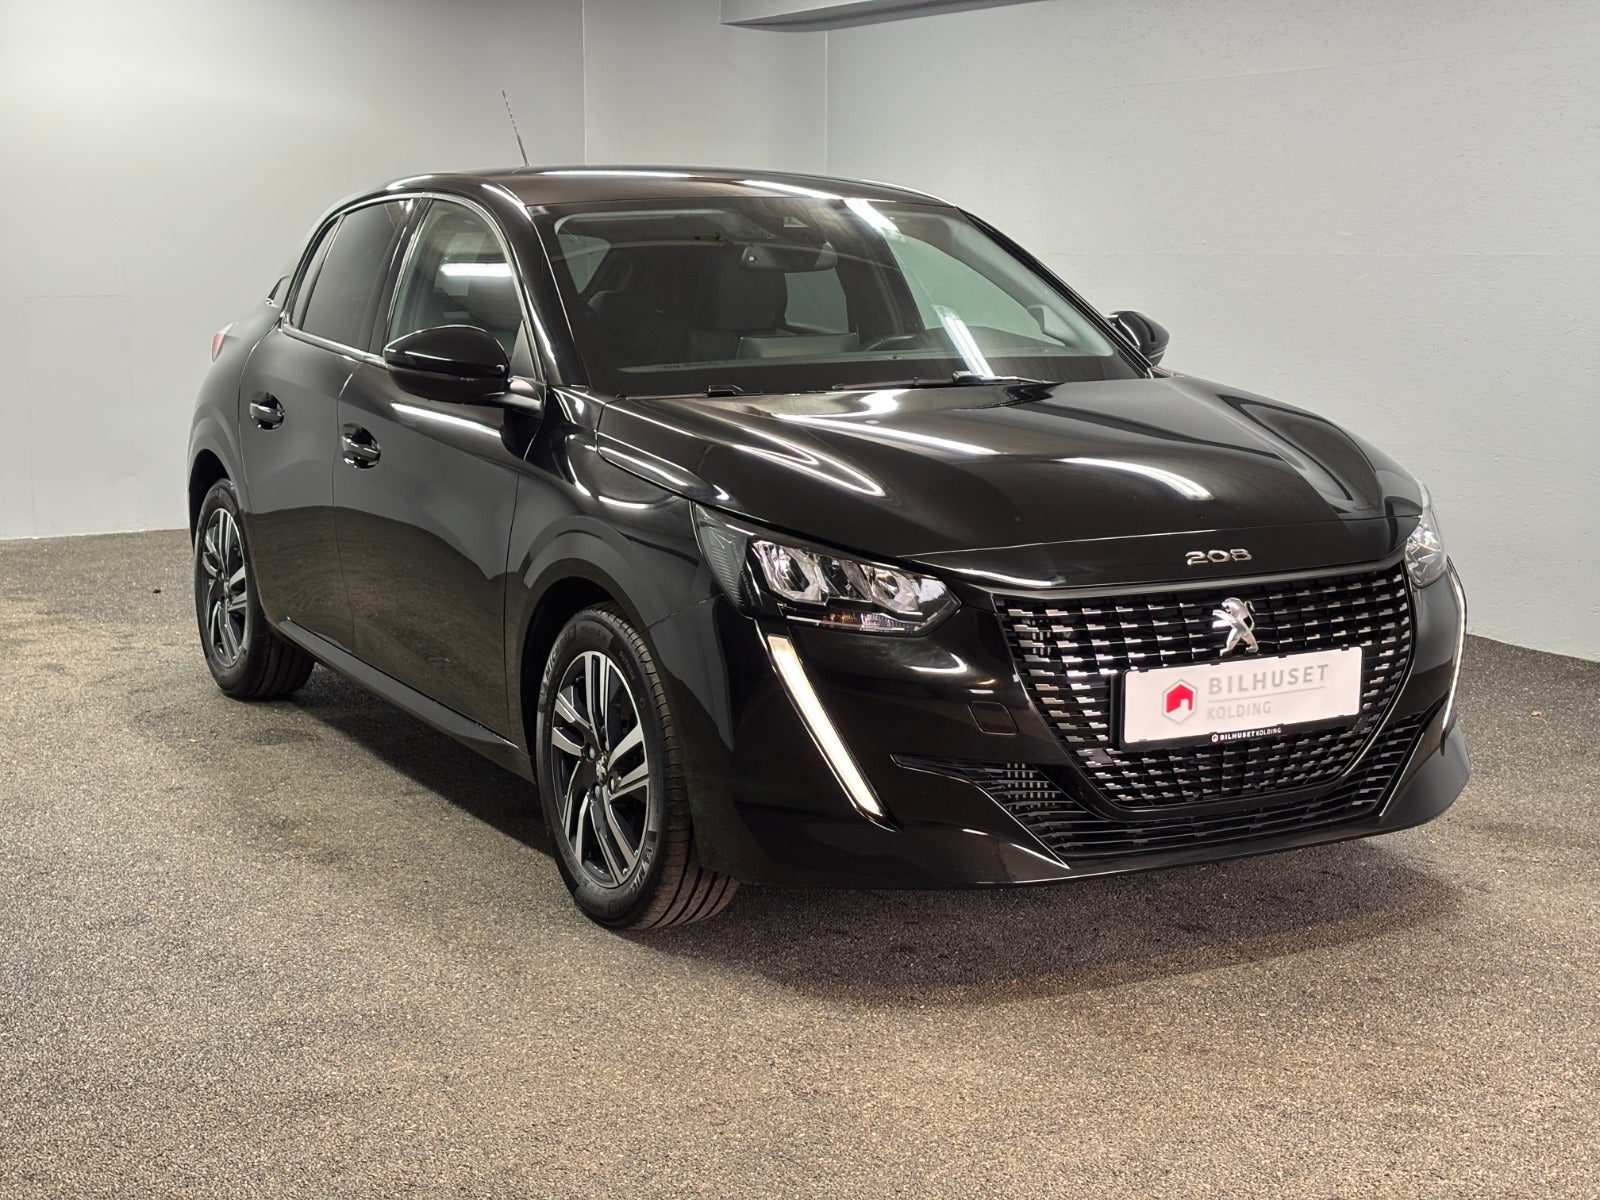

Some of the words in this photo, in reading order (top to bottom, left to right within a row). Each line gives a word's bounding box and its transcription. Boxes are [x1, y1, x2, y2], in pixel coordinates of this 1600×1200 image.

[1185, 548, 1252, 566] 208
[1207, 664, 1329, 696] BILHUSET
[1206, 701, 1272, 721] KOLDING
